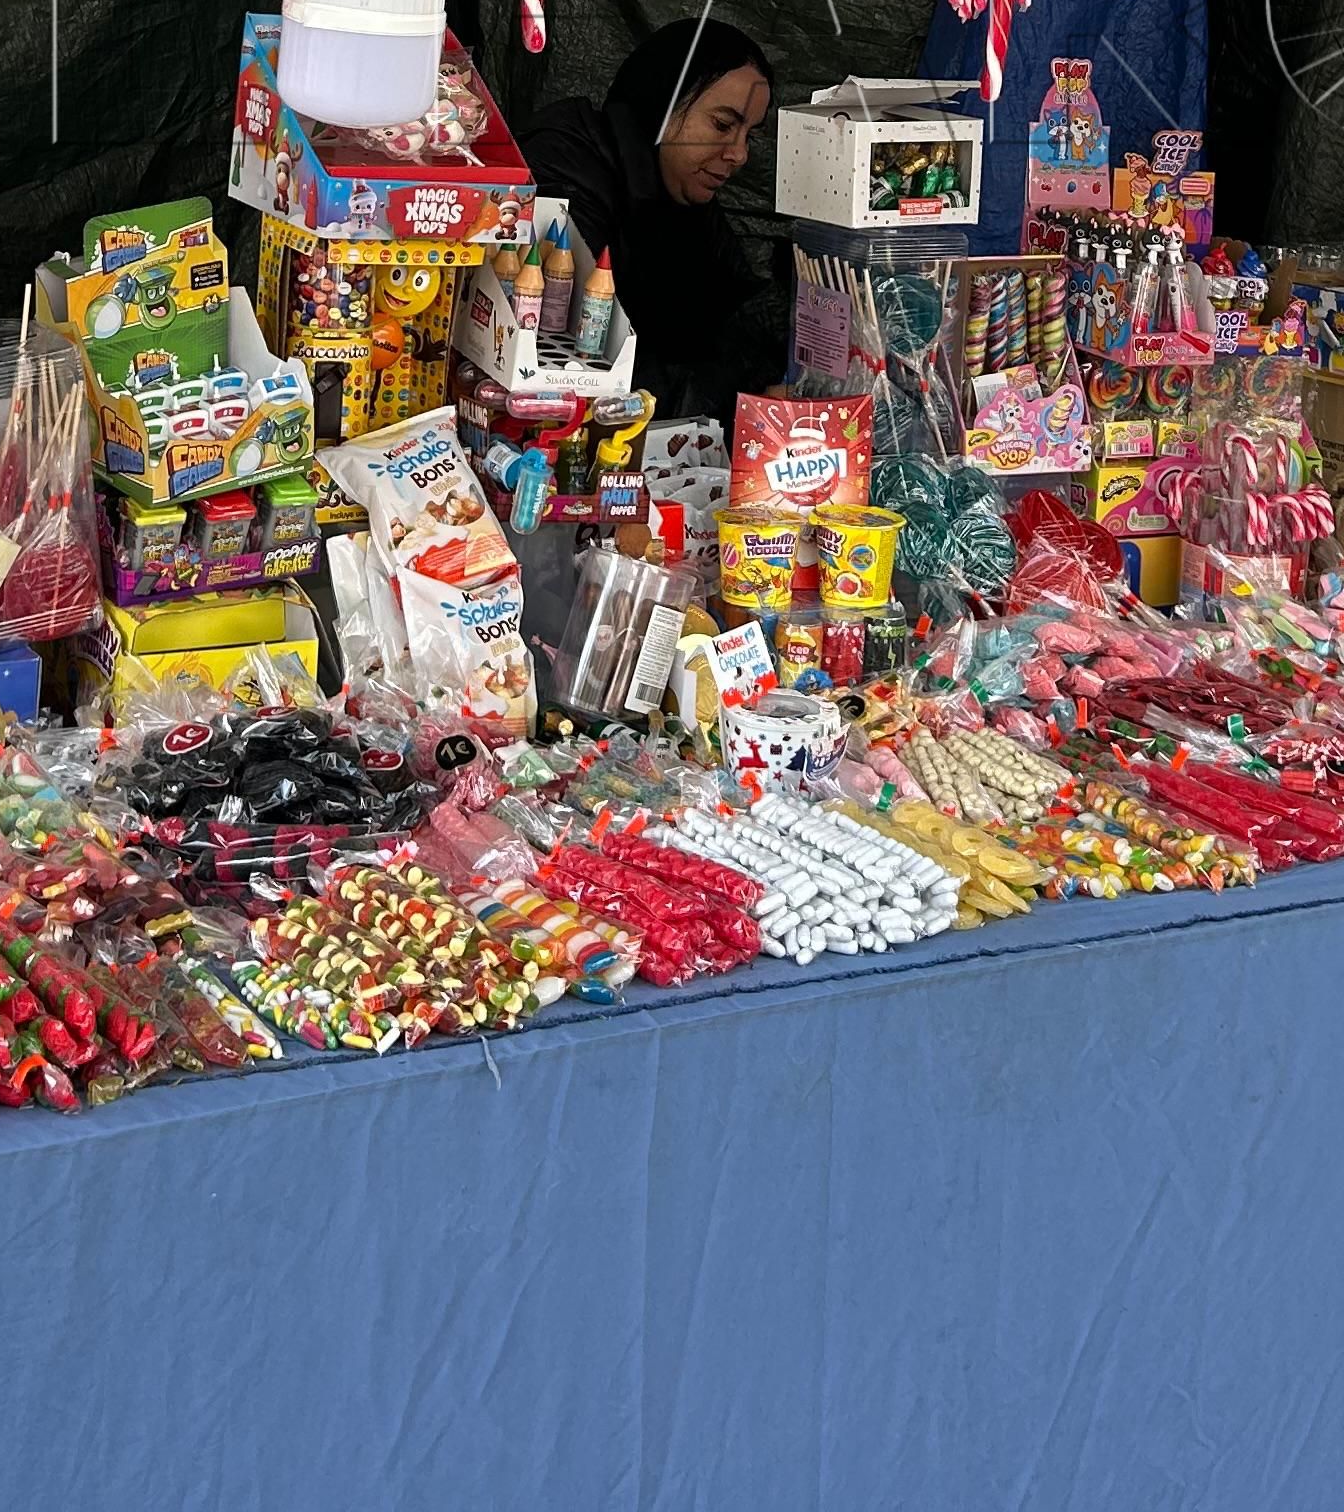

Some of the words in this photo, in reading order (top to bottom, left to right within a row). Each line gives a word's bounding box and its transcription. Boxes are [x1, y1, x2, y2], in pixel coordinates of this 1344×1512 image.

[244, 99, 272, 128] XMAS
[1155, 133, 1199, 149] COOL
[1160, 147, 1188, 161] ICE
[413, 187, 458, 205] MAGIC
[404, 201, 465, 224] XMAS
[412, 219, 449, 236] POP'S
[1217, 326, 1239, 340] ICE
[1133, 337, 1165, 353] PLAY
[1136, 349, 1162, 364] POP
[171, 445, 224, 470] CANDY
[383, 436, 421, 461] Kinder
[785, 444, 824, 459] Kinder
[409, 455, 457, 490] Bons
[774, 452, 841, 484] HAPPY
[600, 474, 645, 489] ROLLING
[599, 488, 639, 506] PAINT
[264, 541, 317, 564] POPPING
[474, 615, 519, 644] Bons
[713, 634, 746, 655] Kinder
[717, 645, 761, 674] CHOCOLATE
[440, 740, 471, 762] 1€
